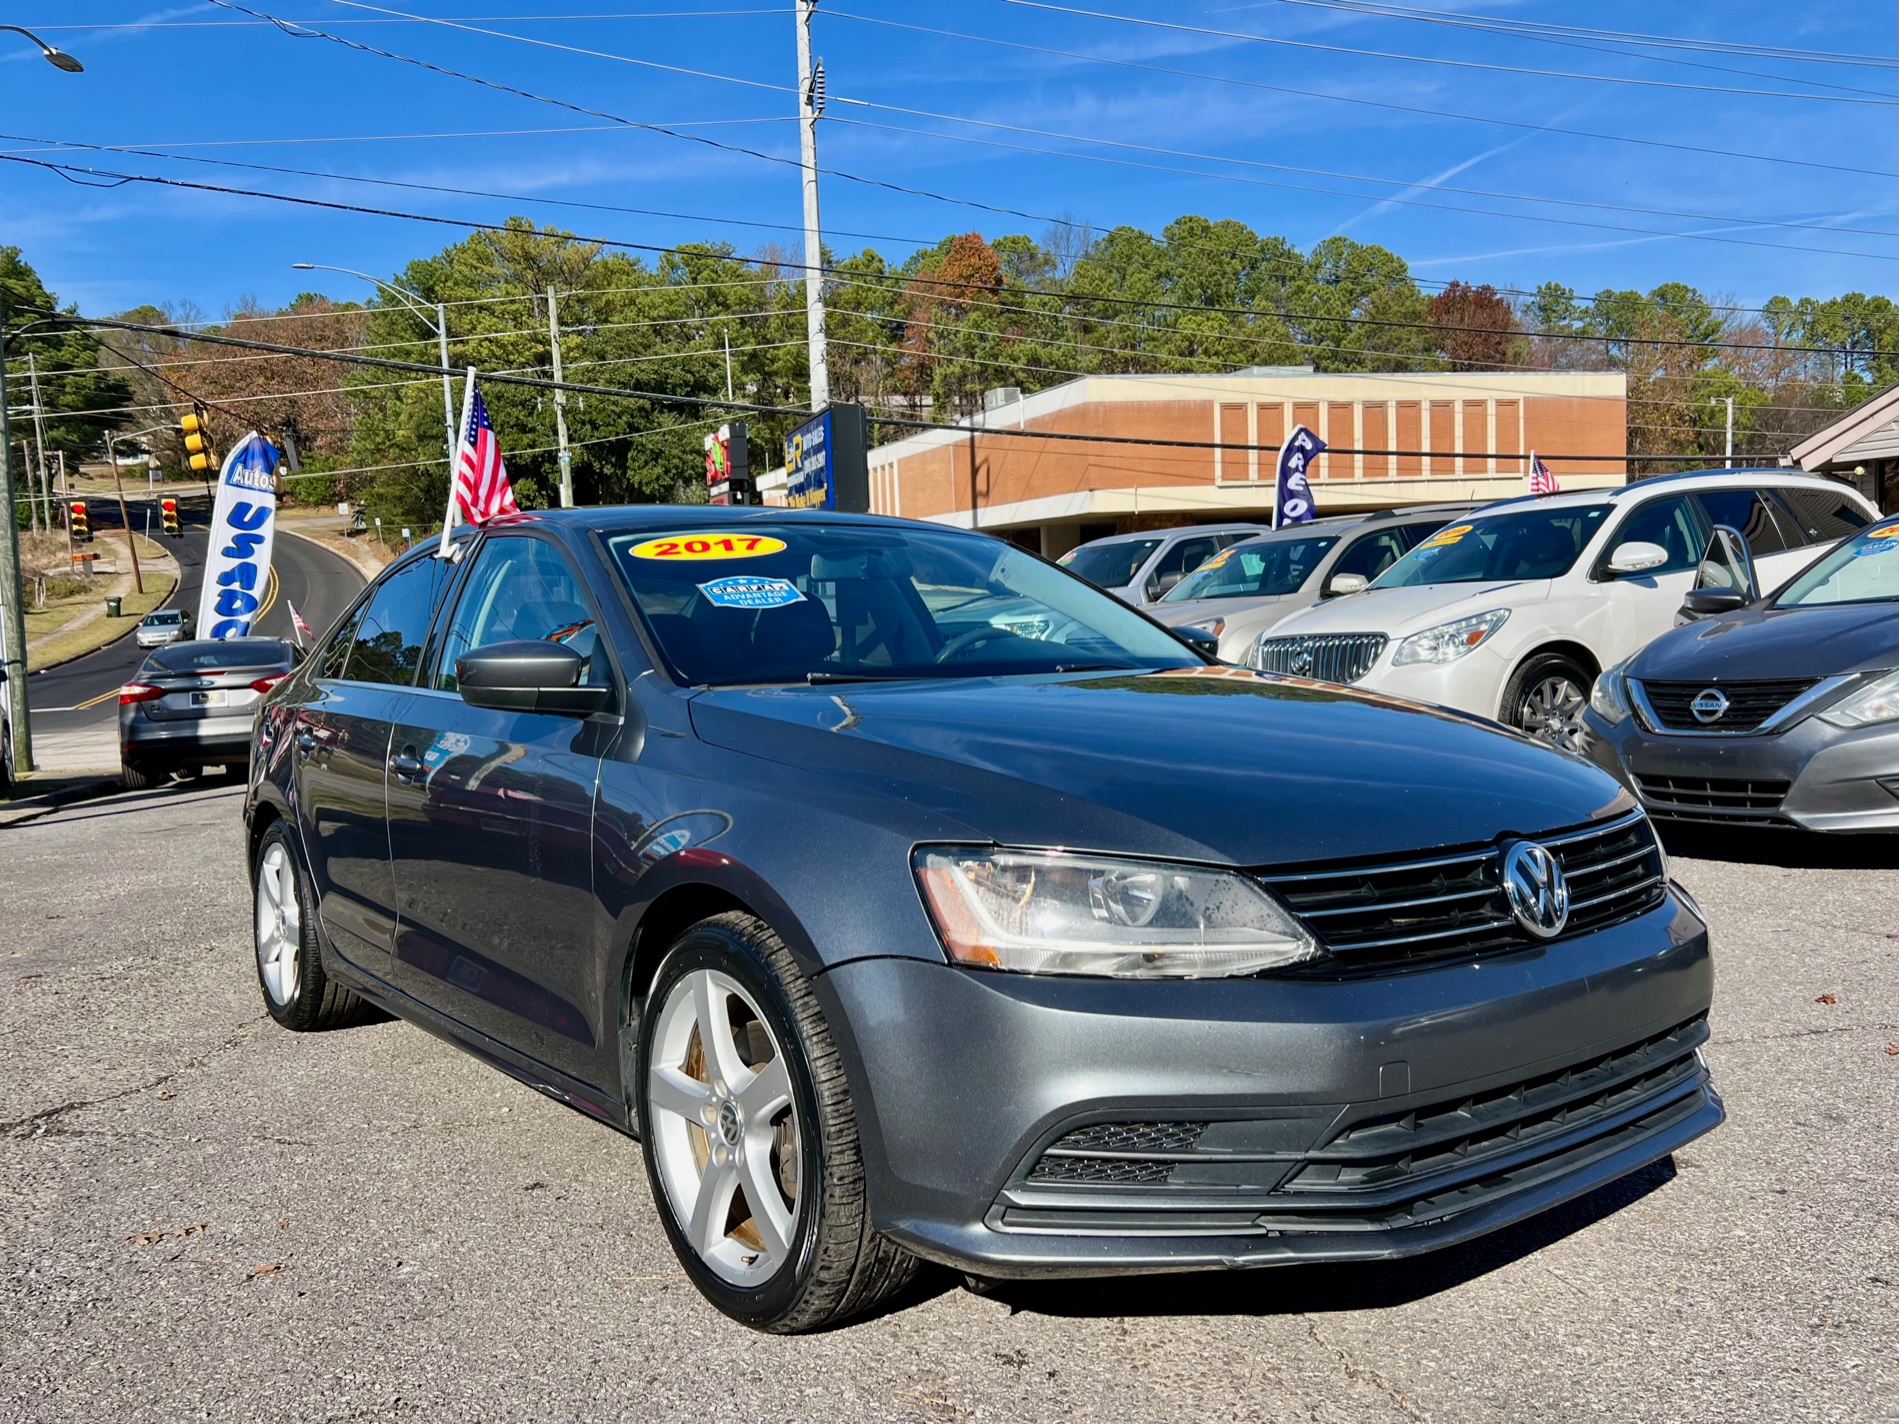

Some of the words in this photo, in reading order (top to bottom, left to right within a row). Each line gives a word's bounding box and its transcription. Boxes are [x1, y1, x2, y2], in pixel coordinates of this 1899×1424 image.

[653, 538, 763, 557] 2017
[710, 583, 789, 595] CARFAX
[723, 591, 789, 601] ADVANTAGE
[738, 597, 783, 606] DEALER
